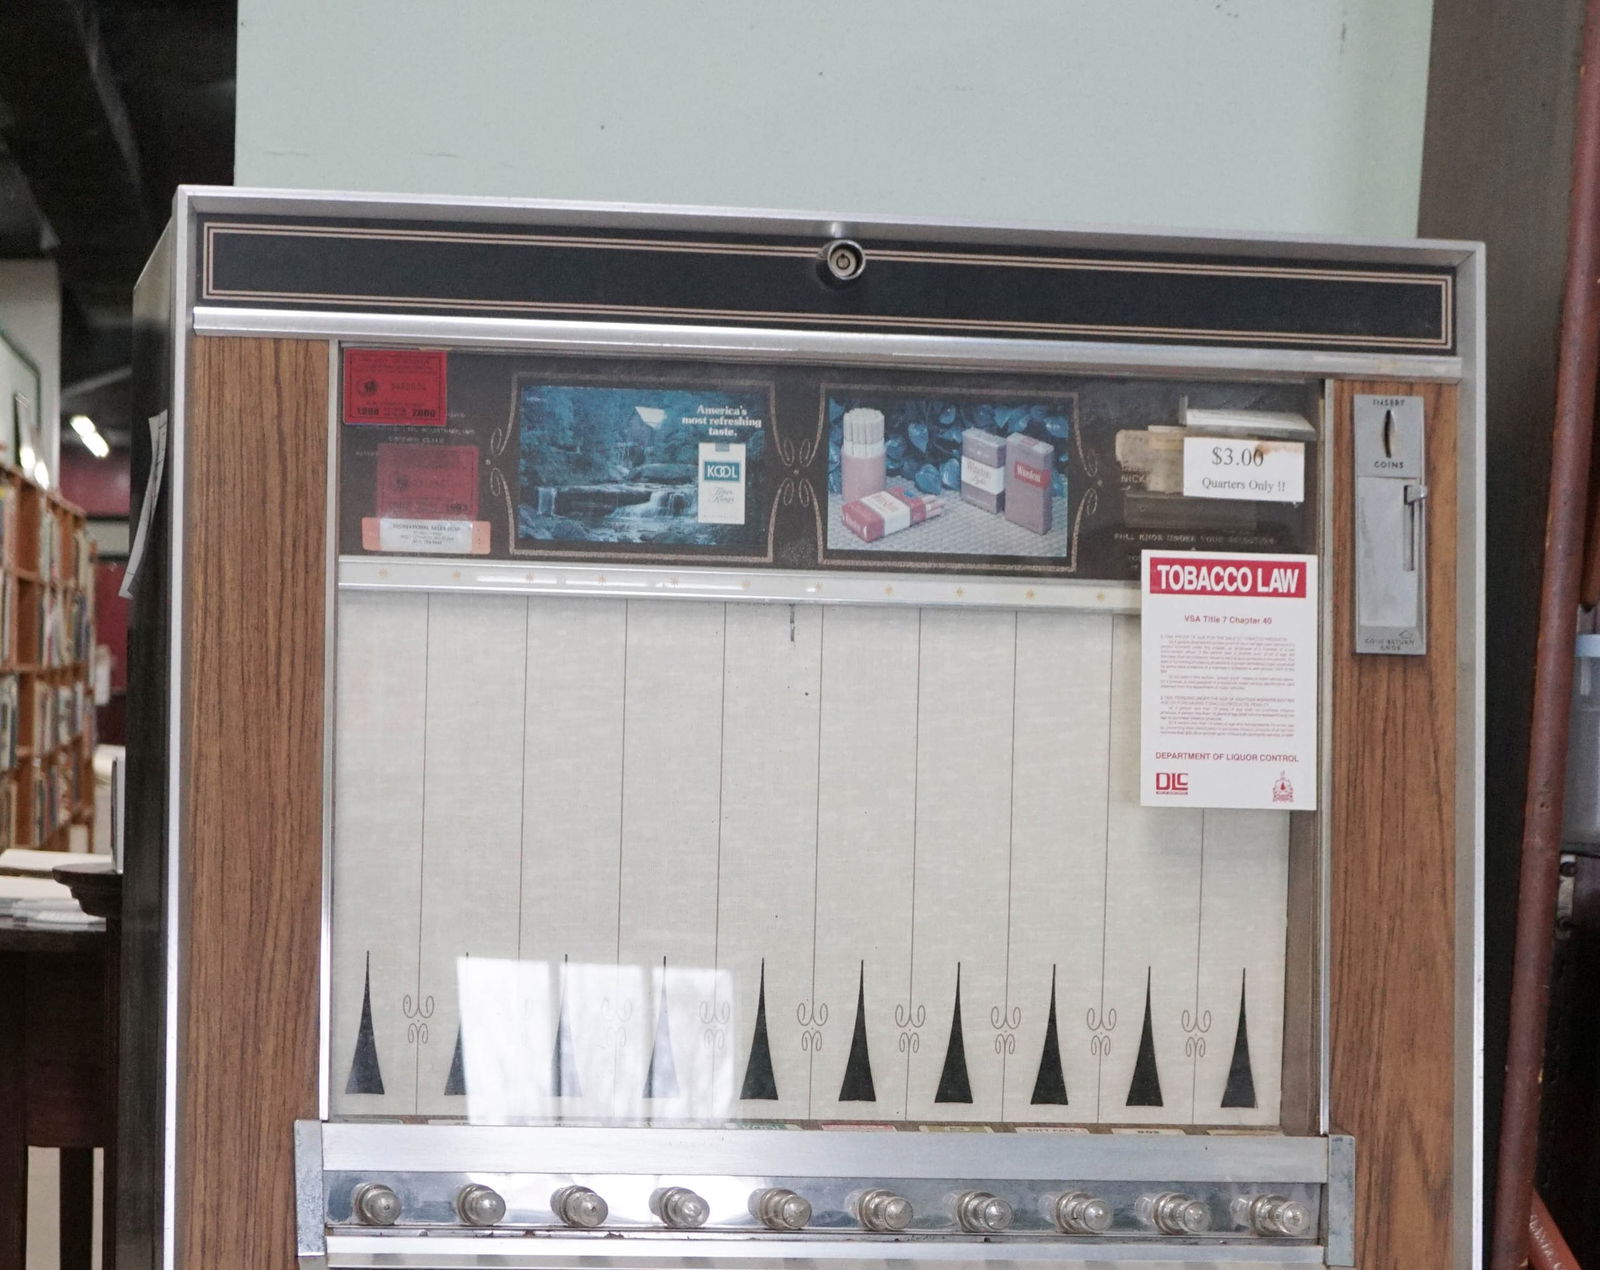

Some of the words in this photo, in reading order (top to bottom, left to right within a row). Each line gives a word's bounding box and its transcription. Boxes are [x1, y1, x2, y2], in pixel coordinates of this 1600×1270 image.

[1373, 399, 1406, 407] INSERT
[697, 404, 748, 415] America's
[682, 416, 708, 425] most
[709, 416, 762, 428] refreshing
[708, 427, 738, 436] taste.
[1212, 446, 1265, 468] $3.00
[707, 464, 738, 478] KOOL
[1374, 461, 1405, 470] COINS
[1016, 463, 1041, 483] Winston
[1202, 476, 1246, 490] Quarters
[1249, 479, 1275, 494] Only
[1277, 480, 1287, 492] !!
[1157, 564, 1253, 593] TOBACCO
[1257, 567, 1299, 593] LAW
[1184, 614, 1201, 623] VSA
[1203, 615, 1221, 624] Title
[1222, 616, 1227, 624] 7
[1229, 615, 1261, 626] Chapter
[1262, 617, 1272, 625] 40
[1155, 751, 1210, 761] DEPARTMENT
[1212, 753, 1225, 761] OF
[1226, 753, 1258, 763] LIQUOR
[1259, 754, 1300, 763] CONTROL
[1155, 772, 1189, 791] DLC
